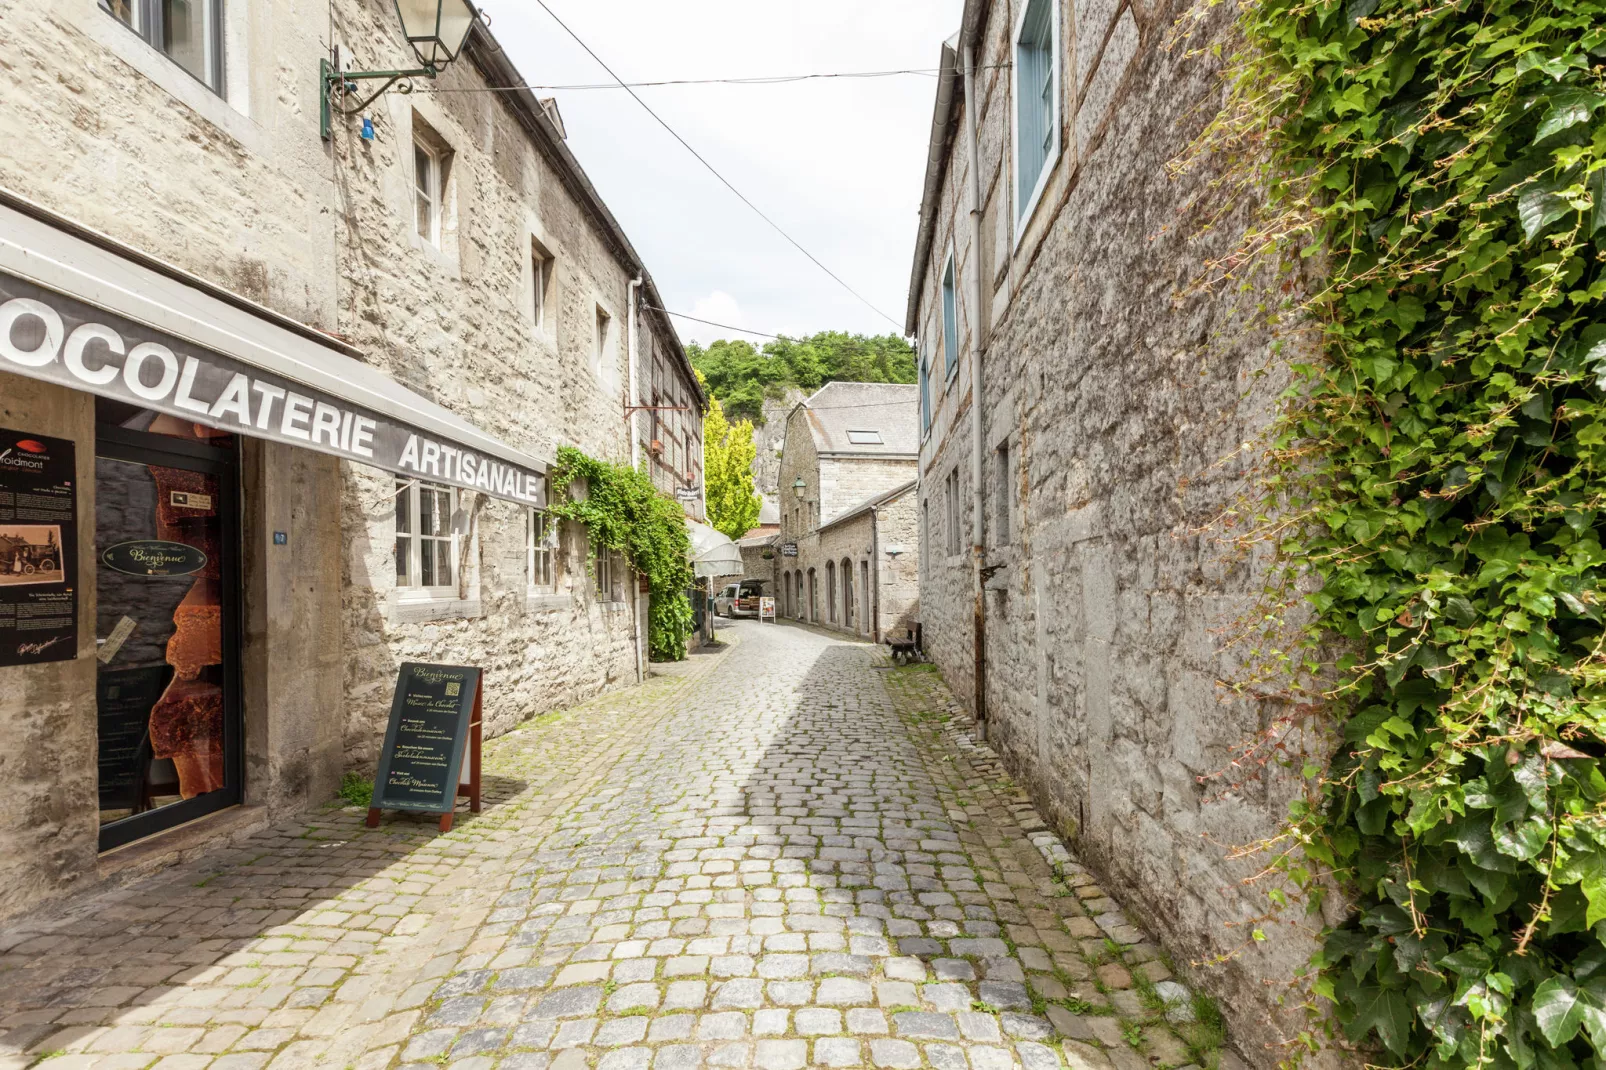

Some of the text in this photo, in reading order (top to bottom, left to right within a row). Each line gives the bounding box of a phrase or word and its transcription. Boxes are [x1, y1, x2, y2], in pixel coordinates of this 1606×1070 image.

[0, 298, 538, 502] OCOLATERIE ARTISANALE
[17, 452, 50, 460] CHOCOLATIER
[129, 549, 187, 569] Bienvenue
[413, 667, 464, 684] Bienvenue
